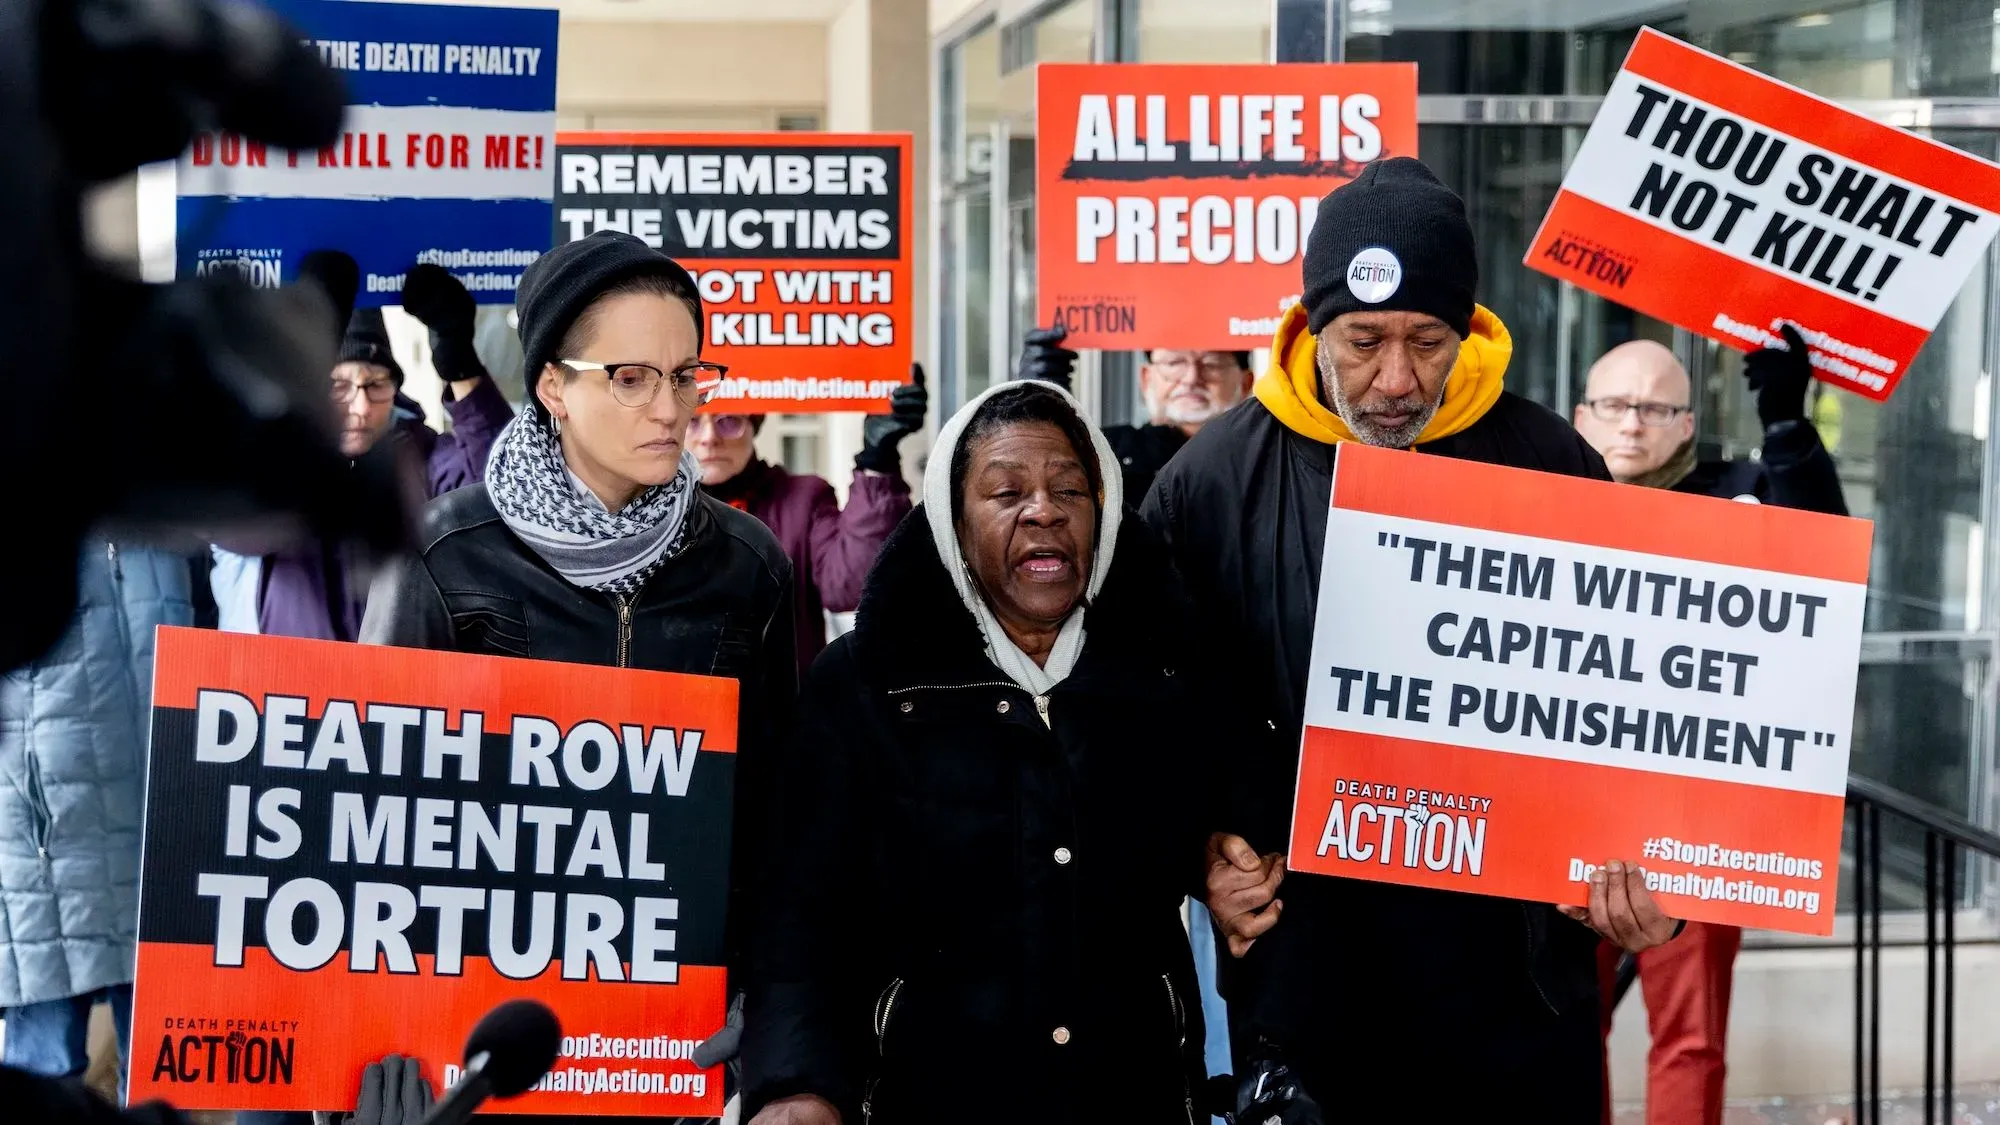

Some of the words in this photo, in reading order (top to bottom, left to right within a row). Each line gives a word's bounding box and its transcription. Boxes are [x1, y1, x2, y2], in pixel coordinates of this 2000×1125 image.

[316, 40, 360, 71] THE
[364, 41, 441, 74] DEATH
[444, 44, 542, 77] PENALTY
[193, 131, 298, 168] DON
[405, 134, 470, 170] FOR
[484, 134, 545, 171] ME!
[1073, 94, 1176, 162] ALL
[1189, 94, 1306, 162] LIFE
[1319, 92, 1383, 163] IS
[559, 152, 889, 196] REMEMBER
[1624, 83, 1787, 187] THOU
[1784, 152, 1979, 258] SHALT
[198, 249, 233, 259] DEATH
[235, 248, 283, 259] PENALTY
[559, 207, 664, 248] THE
[675, 207, 892, 250] VICTIMS
[1076, 195, 1319, 265] PRECIO
[1629, 162, 1758, 246] NOT
[1750, 212, 1902, 303] KILL!
[688, 269, 765, 304] OT
[774, 269, 893, 304] WITH
[1350, 264, 1395, 284] ACTION
[1543, 237, 1634, 289] ACTION
[709, 312, 894, 347] KILLING
[1377, 531, 1555, 601] "THEM
[1573, 560, 1828, 638] WITHOUT
[1426, 612, 1644, 684] CAPITAL
[1659, 644, 1759, 697] GET
[195, 688, 484, 782] DEATH
[510, 713, 704, 798] ROW
[1330, 666, 1432, 724] THE
[1448, 683, 1836, 772] PUNISHMENT"
[1335, 778, 1397, 801] DEATH
[1404, 788, 1492, 813] PENALTY
[225, 784, 302, 860] IS
[330, 791, 666, 882] MENTAL
[1316, 799, 1488, 876] ACTION
[1642, 836, 1823, 880] #StopExecutions
[1568, 857, 1820, 914] DeenaltyAction.org
[197, 872, 680, 984] TORTURE
[165, 1017, 218, 1031] DEATH
[226, 1019, 299, 1033] PENALTY
[152, 1031, 295, 1085] ACTION
